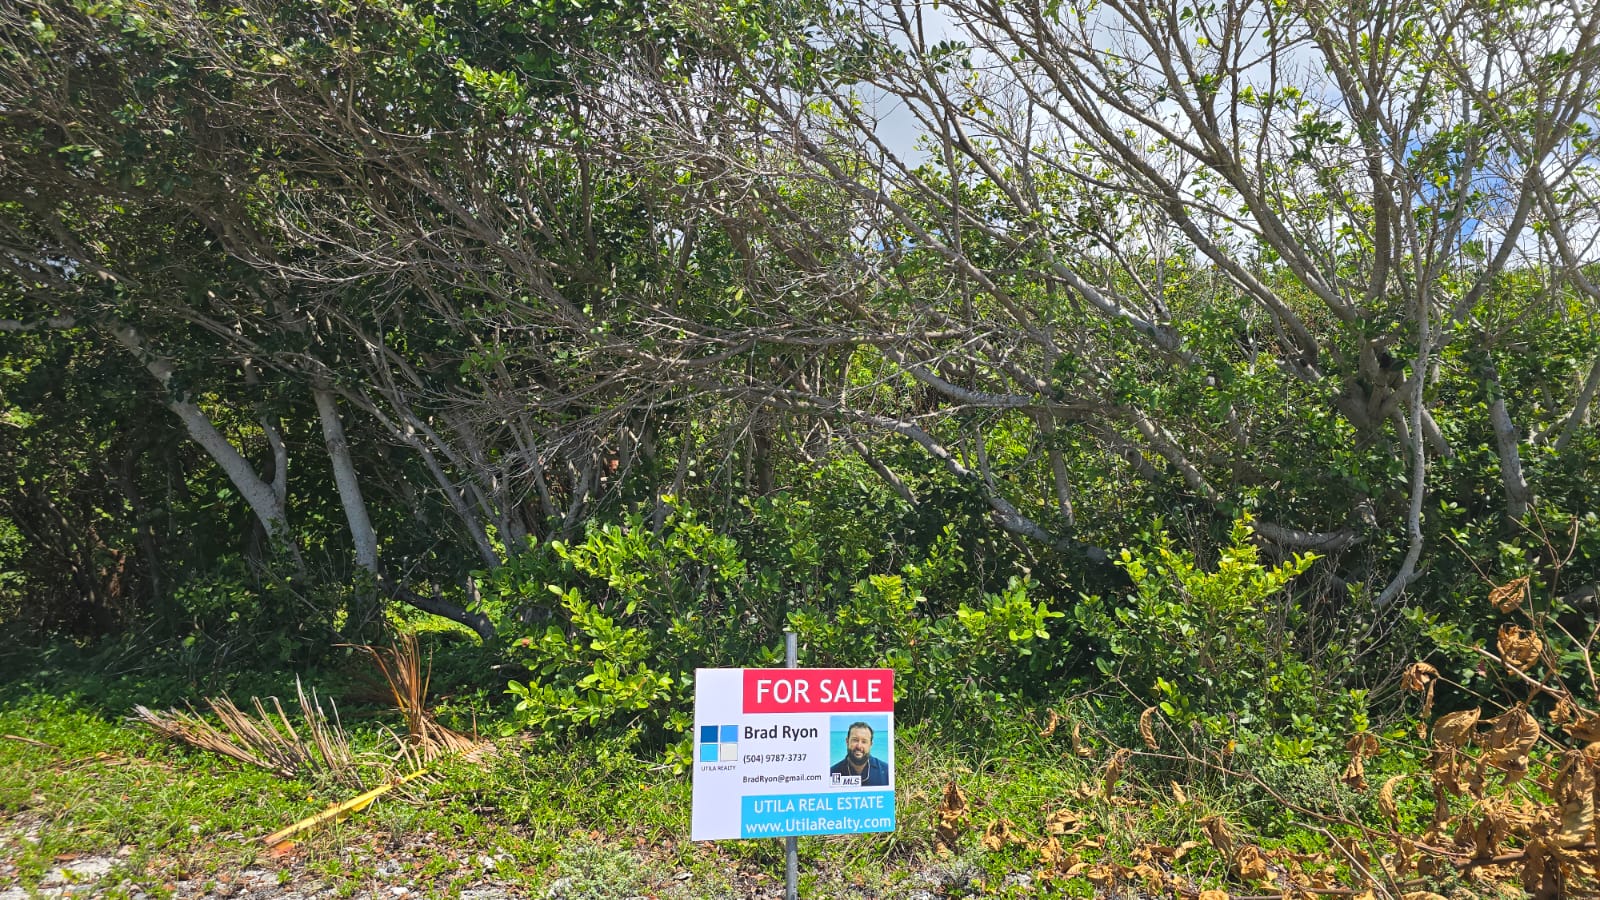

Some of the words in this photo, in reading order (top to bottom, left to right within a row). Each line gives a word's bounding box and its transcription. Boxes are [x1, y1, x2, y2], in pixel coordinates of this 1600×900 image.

[756, 679, 811, 704] FOR
[819, 679, 882, 703] SALE
[744, 725, 778, 740] Brad
[782, 725, 818, 742] Ryon
[743, 754, 764, 765] (504)
[765, 753, 807, 763] 9787-3737
[742, 773, 822, 784] BradRyon@gmail.com
[842, 777, 860, 786] MLS
[754, 799, 796, 814] UTILA
[799, 797, 833, 812] REAL
[836, 795, 885, 811] ESTATE
[745, 816, 892, 833] www.UtilaRealty.com
